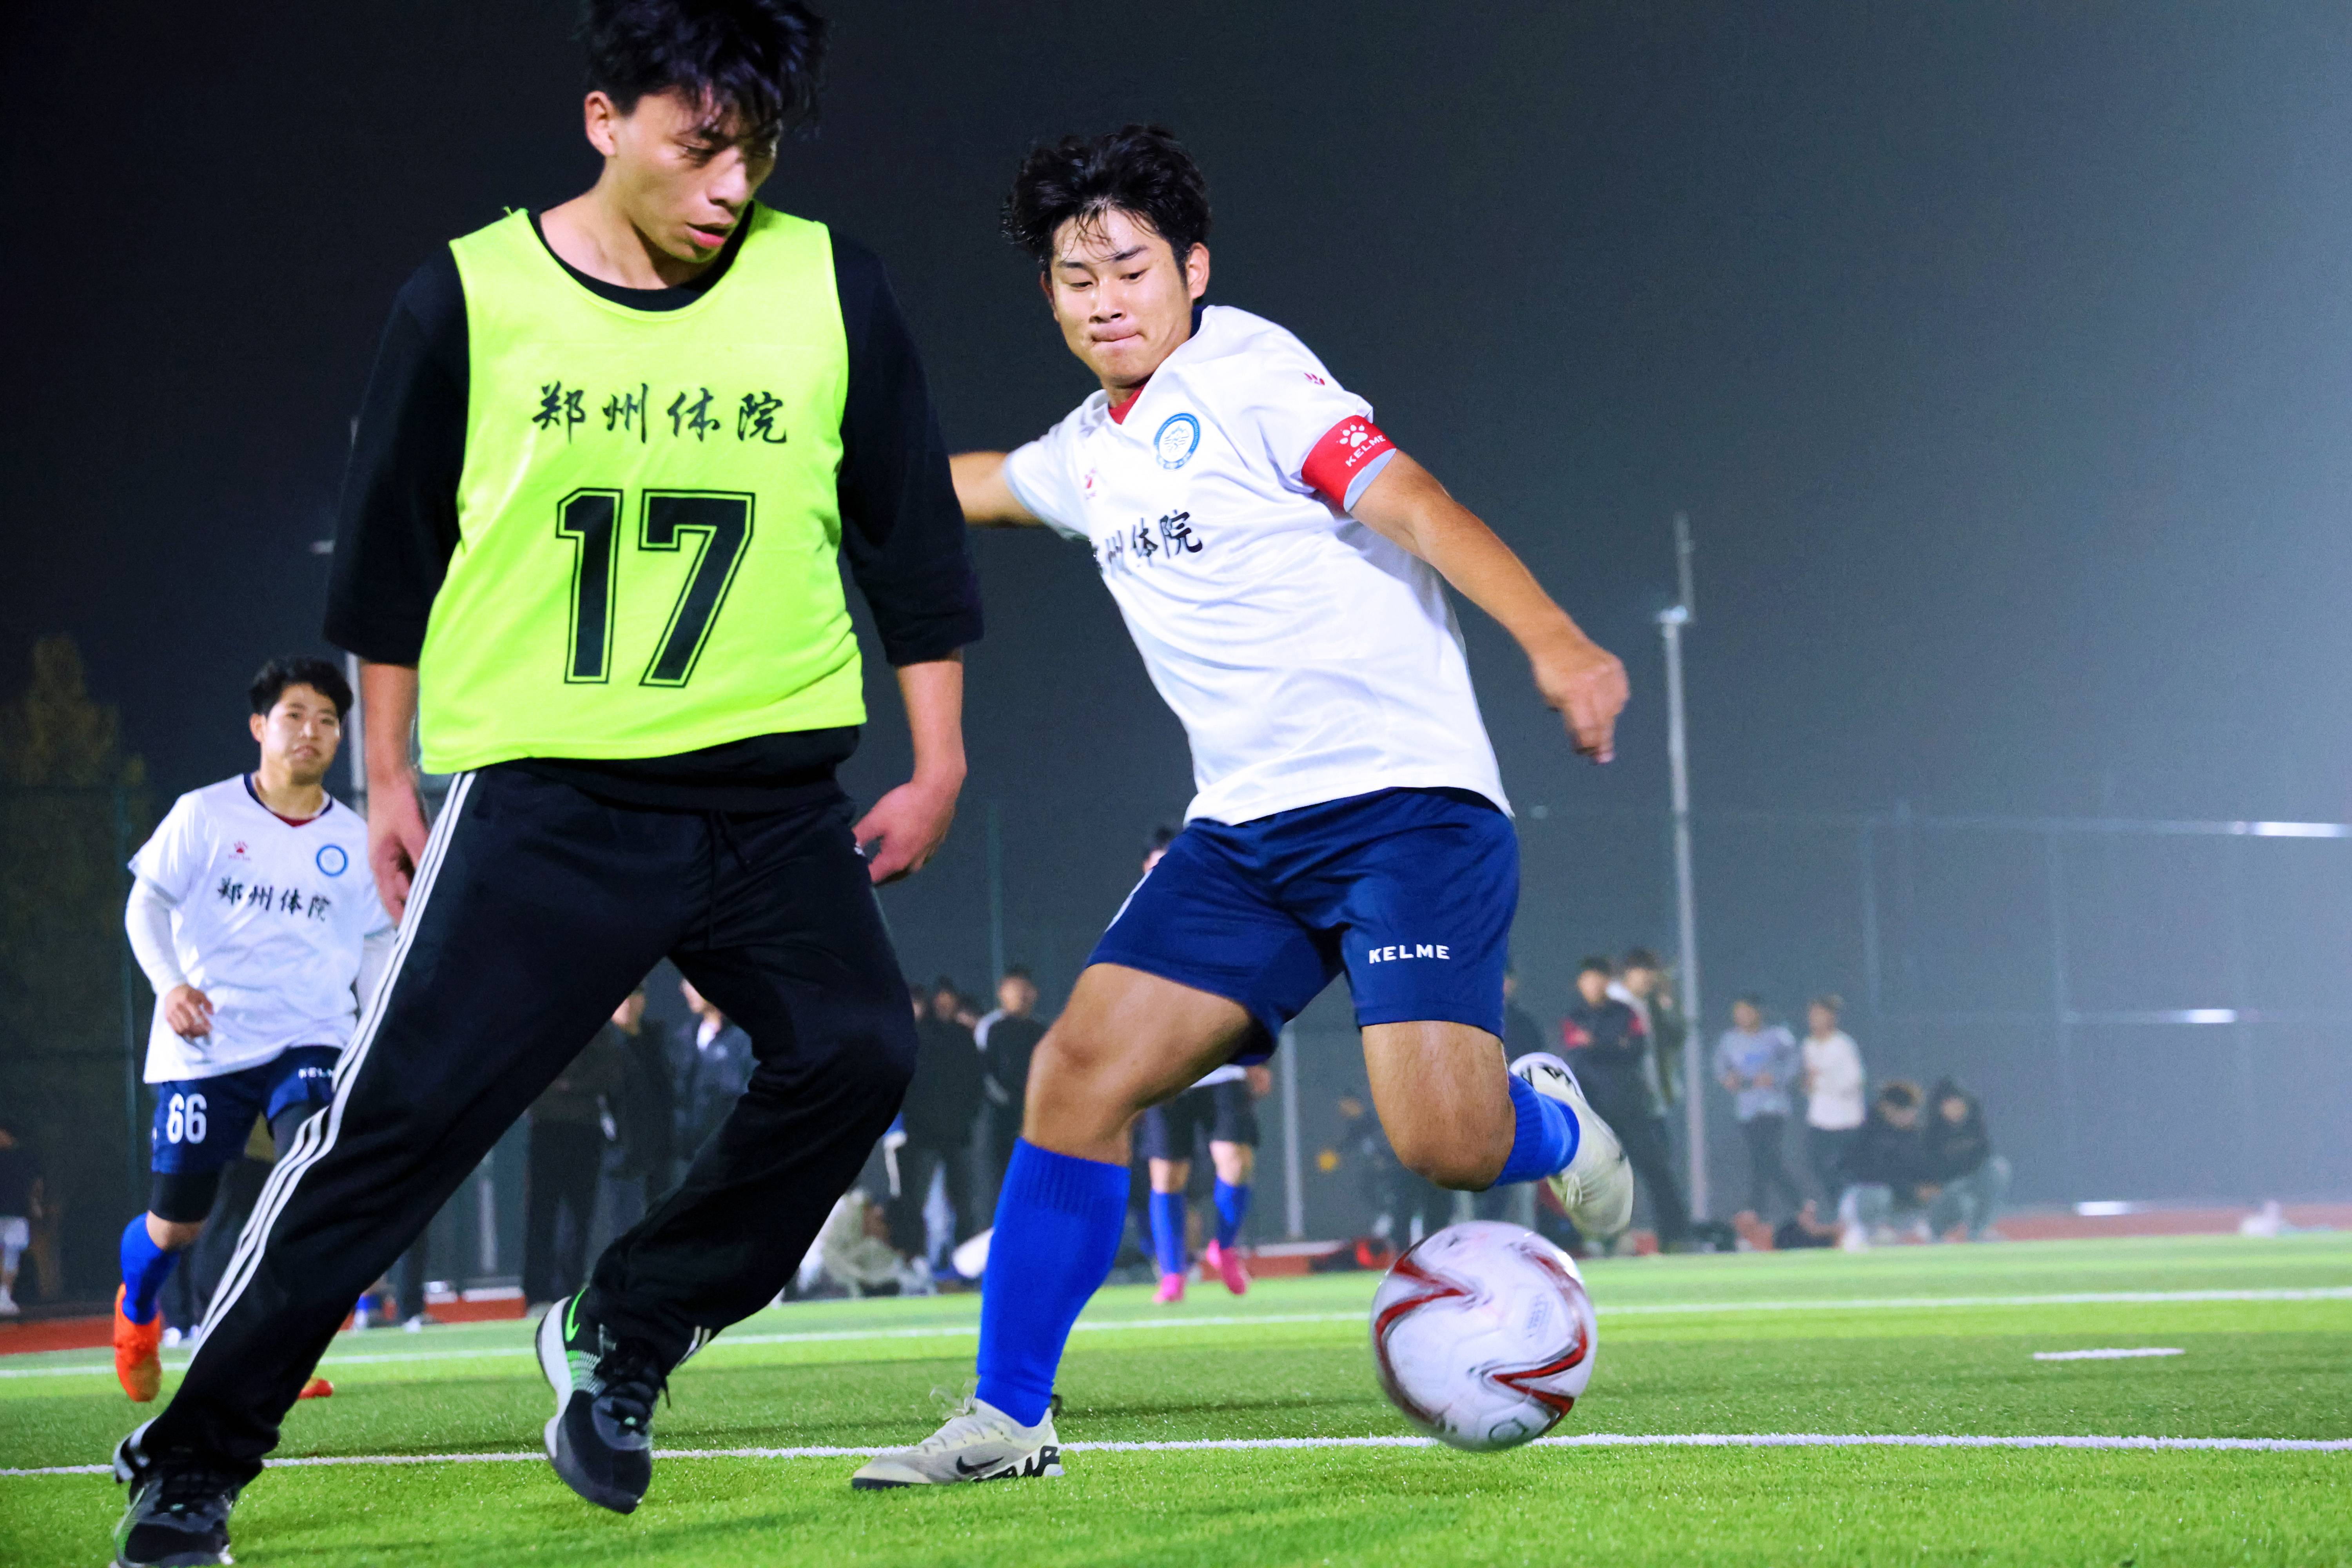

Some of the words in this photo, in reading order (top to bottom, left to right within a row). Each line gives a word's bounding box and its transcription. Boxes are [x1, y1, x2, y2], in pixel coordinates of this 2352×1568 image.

[532, 381, 787, 444] 郑州体院
[1345, 435, 1386, 467] KELME
[1096, 509, 1203, 579] 州体院
[556, 487, 755, 688] 17
[217, 877, 331, 922] 郑州体院
[1368, 944, 1450, 964] KELME
[298, 1067, 332, 1079] KEL
[166, 1093, 207, 1144] 66
